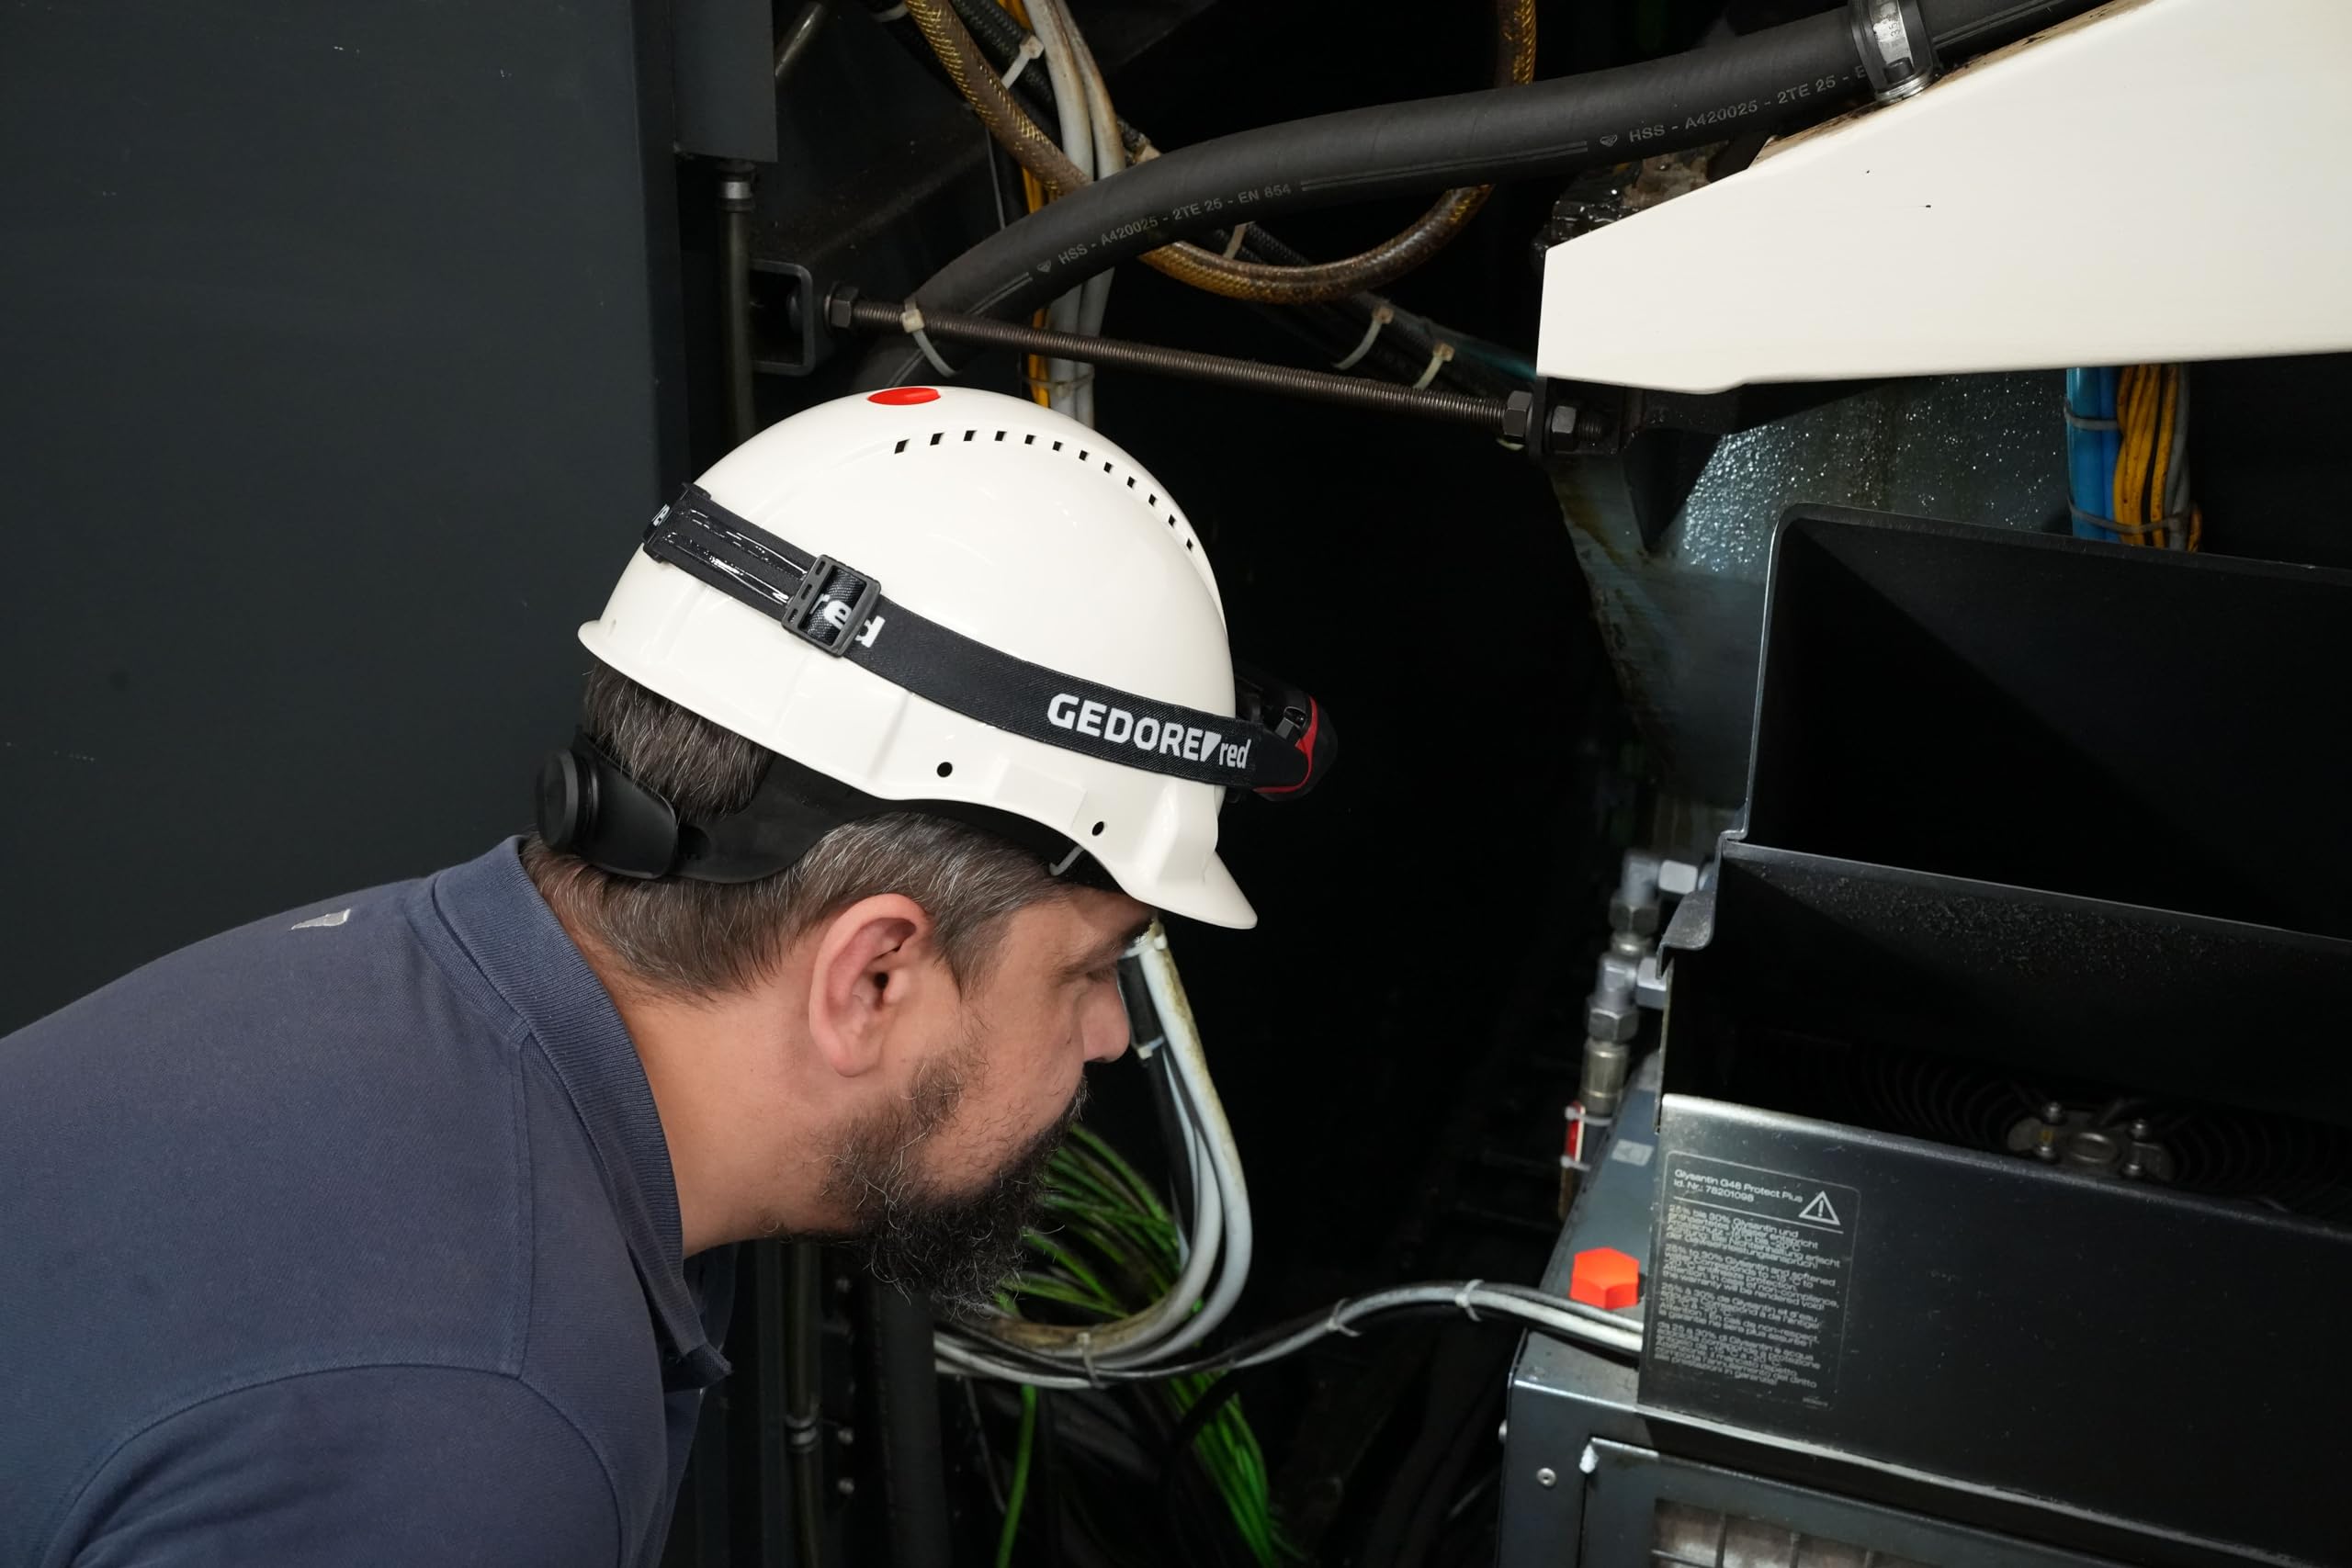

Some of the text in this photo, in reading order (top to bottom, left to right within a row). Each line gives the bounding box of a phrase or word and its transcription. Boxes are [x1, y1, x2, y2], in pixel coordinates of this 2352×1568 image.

[1629, 123, 1666, 143] HSS
[1684, 100, 1758, 130] A420025
[1777, 83, 1811, 105] 2TE
[1815, 74, 1837, 94] 25
[1854, 65, 1867, 79] E
[1058, 244, 1089, 265] HSS
[1100, 217, 1159, 246] A420025
[1172, 203, 1201, 221] 2TE
[1204, 197, 1224, 212] 25
[1238, 189, 1260, 204] EN
[1046, 693, 1252, 770] GEDORE red
[1674, 1168, 1718, 1186] Glysantin
[1743, 1182, 1780, 1197] Protect
[1781, 1190, 1803, 1201] Plus
